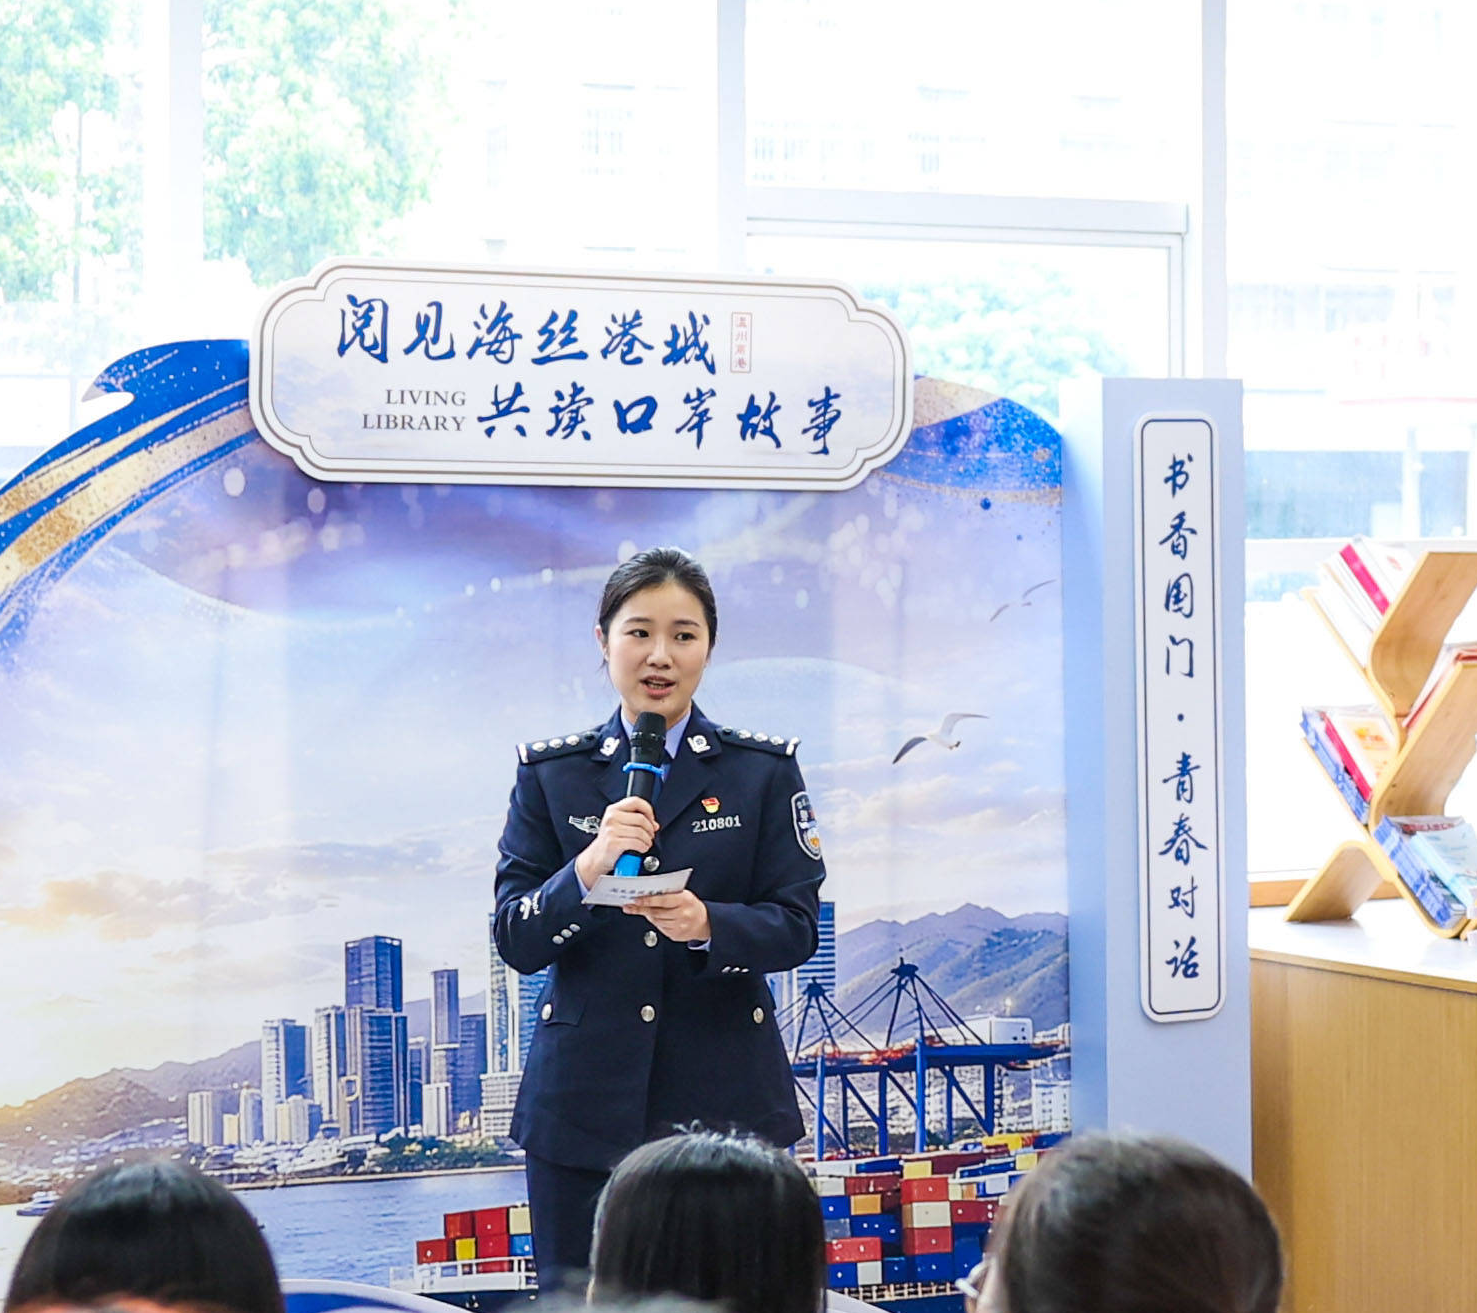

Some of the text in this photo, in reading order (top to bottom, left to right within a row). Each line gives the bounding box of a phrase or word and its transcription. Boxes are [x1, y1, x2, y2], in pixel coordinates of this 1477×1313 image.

[336, 294, 717, 375] 阅见海丝港城
[385, 389, 466, 407] LIVING
[362, 413, 466, 432] LIBRARY
[477, 382, 843, 455] 共读口岸故事
[691, 814, 742, 834] 210801
